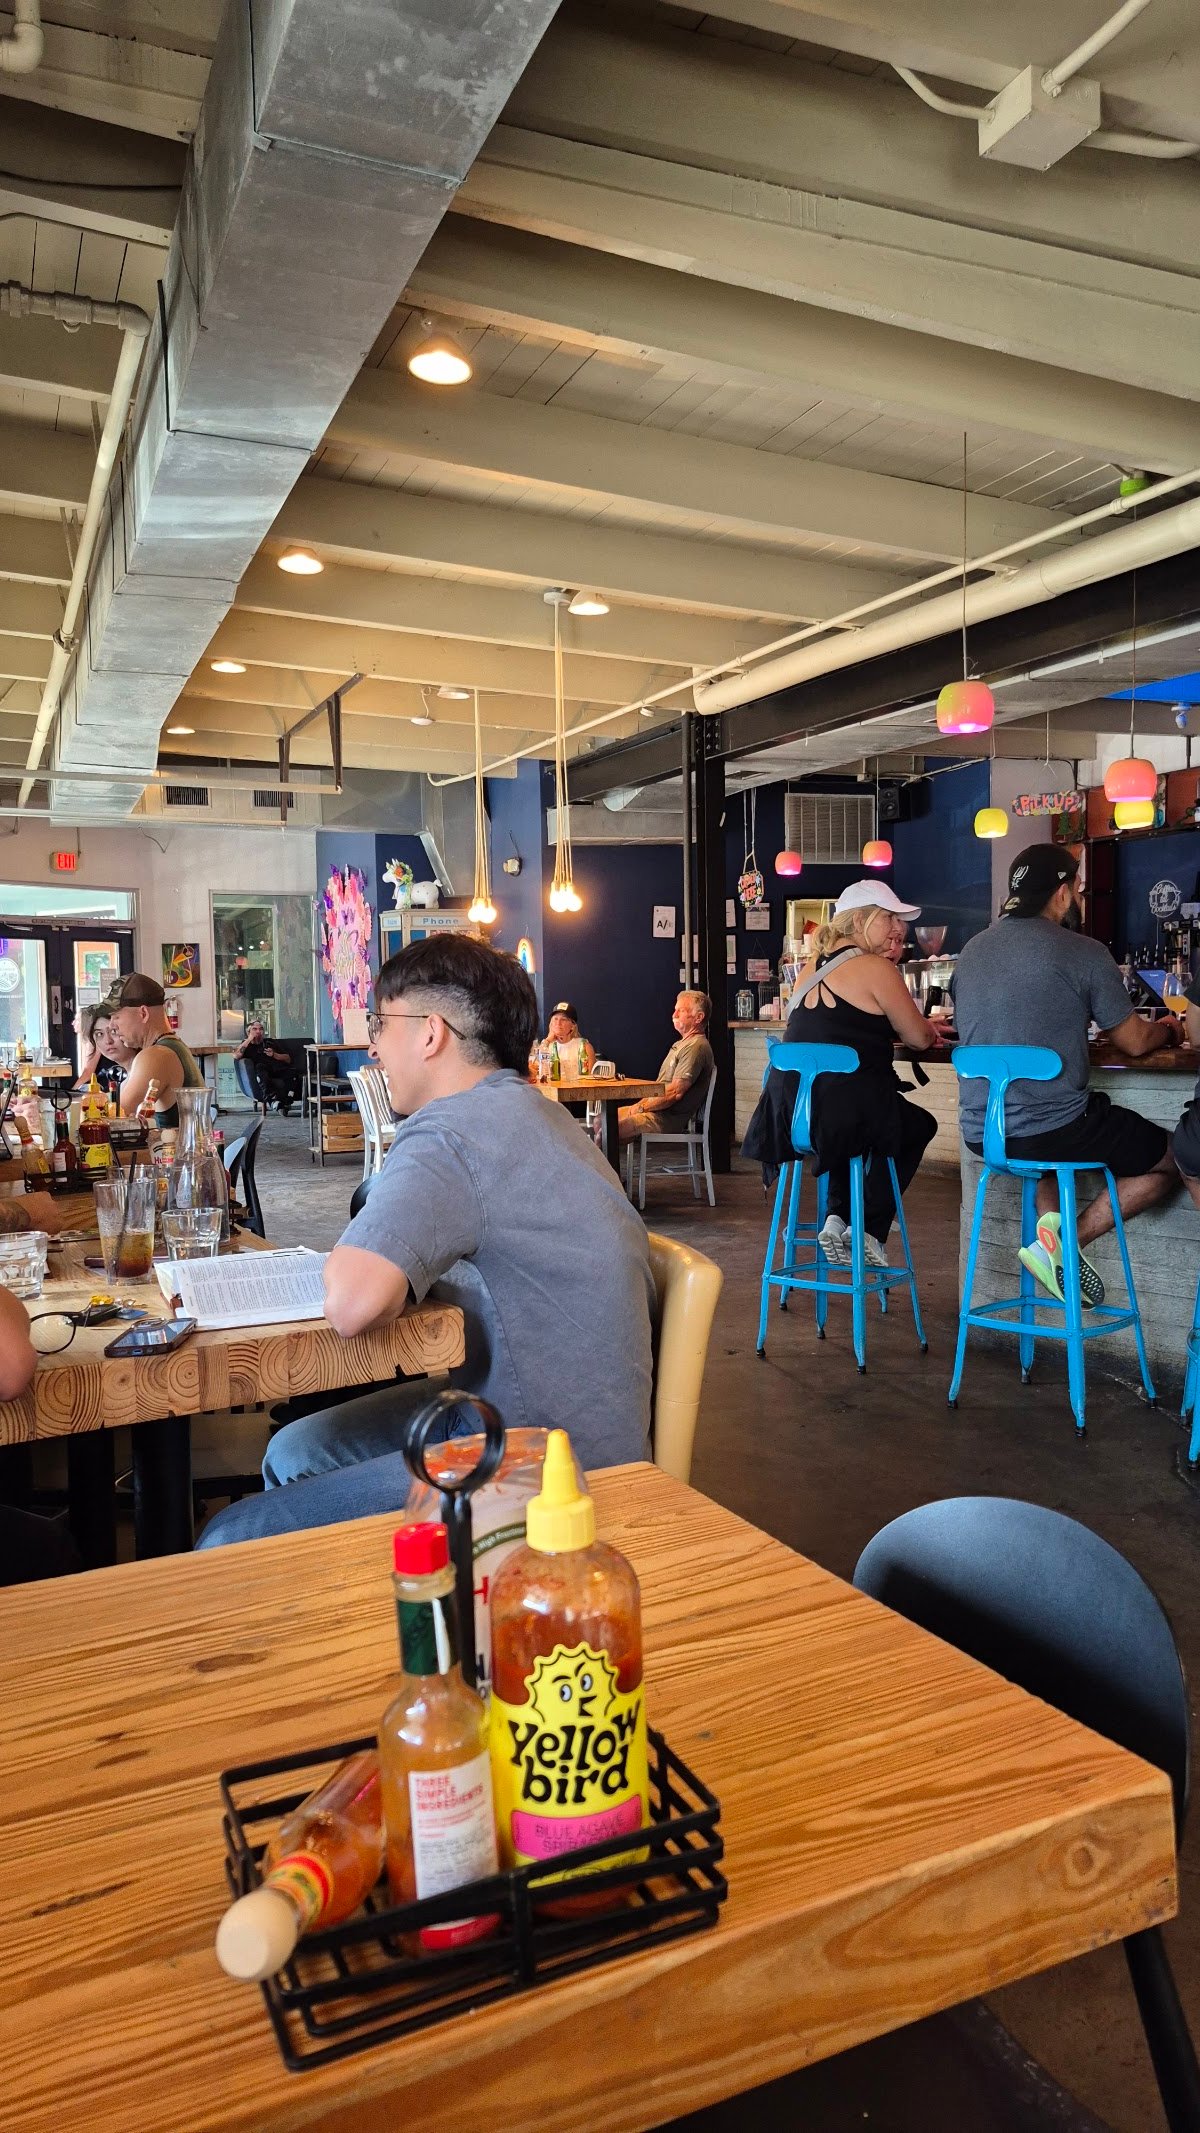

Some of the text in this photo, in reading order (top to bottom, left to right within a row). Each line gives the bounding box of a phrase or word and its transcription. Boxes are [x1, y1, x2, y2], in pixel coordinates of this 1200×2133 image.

[57, 853, 75, 869] EXIT
[423, 917, 459, 925] Phone
[478, 1535, 496, 1549] High
[522, 1744, 629, 1804] bird
[416, 1786, 457, 1799] SIMPLE
[417, 1782, 484, 1811] INGREDIENTS
[536, 1823, 570, 1838] BLUE
